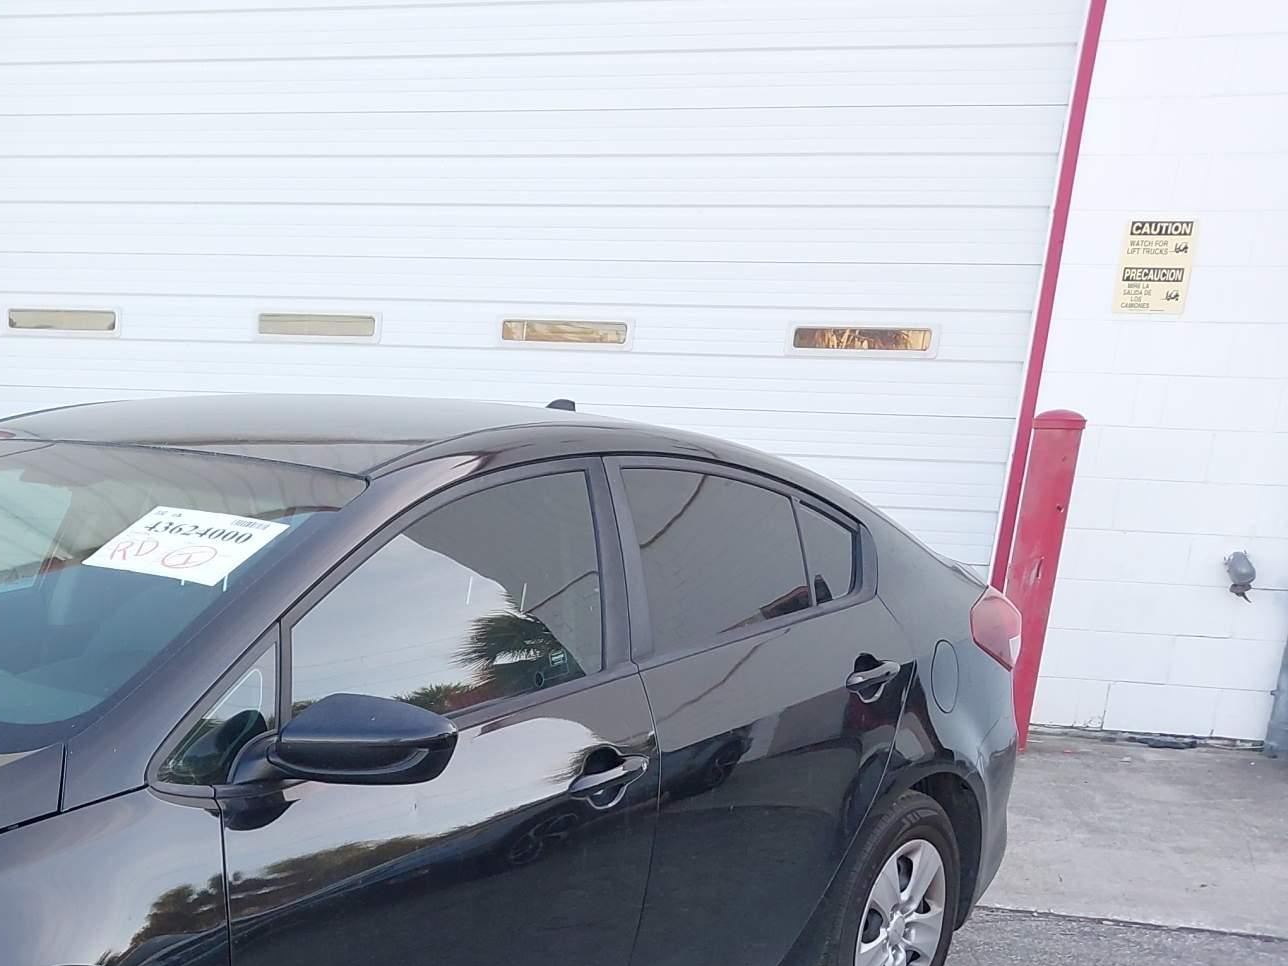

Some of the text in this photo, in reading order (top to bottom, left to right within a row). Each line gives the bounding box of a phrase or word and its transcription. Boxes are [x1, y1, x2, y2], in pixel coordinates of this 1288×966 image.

[1132, 223, 1192, 235] CAUTION
[1129, 239, 1169, 247] WATCH FOR
[1126, 247, 1169, 255] LIFT TRUCKS
[1124, 268, 1182, 281] PRECAUCION
[144, 520, 253, 544] 43624000
